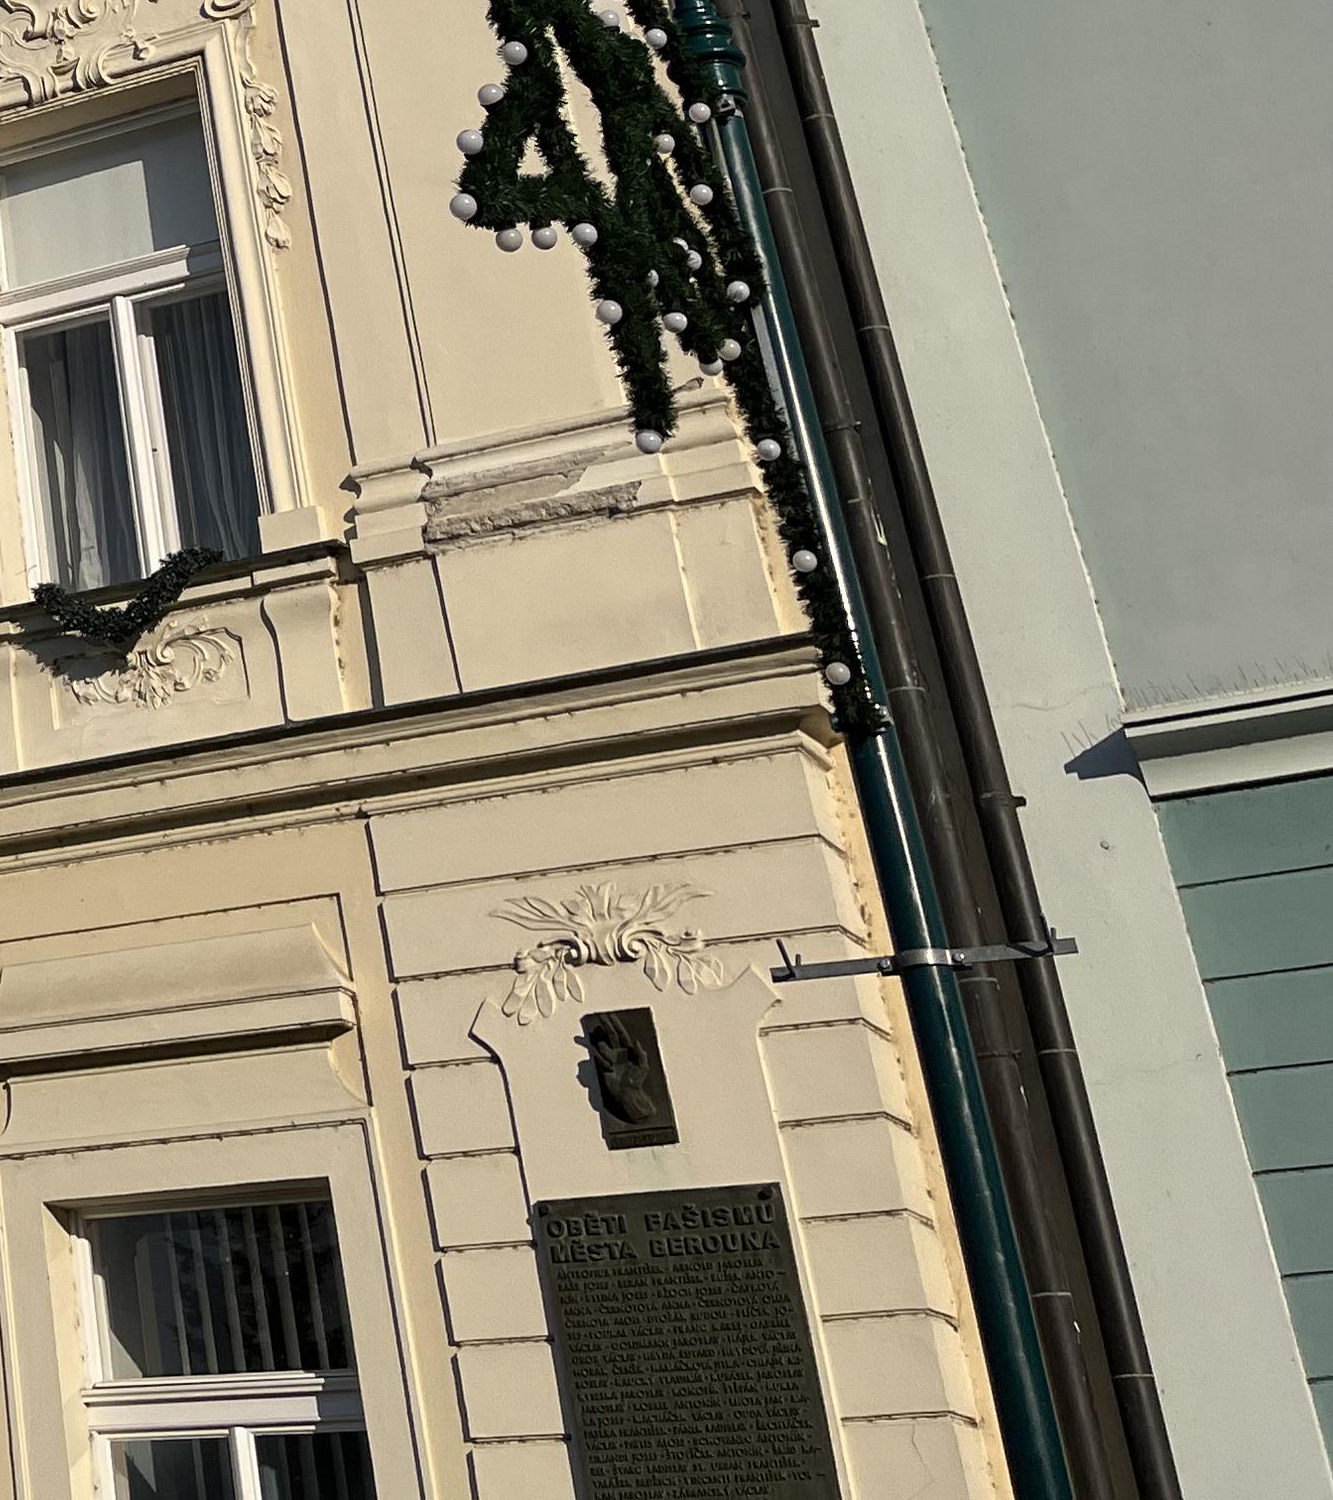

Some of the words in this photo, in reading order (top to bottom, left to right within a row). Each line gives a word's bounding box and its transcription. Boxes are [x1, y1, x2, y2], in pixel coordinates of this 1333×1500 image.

[546, 1211, 628, 1239] OBĚTI
[644, 1203, 776, 1232] FAŠISMU
[550, 1239, 637, 1264] MĚSTA
[650, 1228, 781, 1258] BEROUNA
